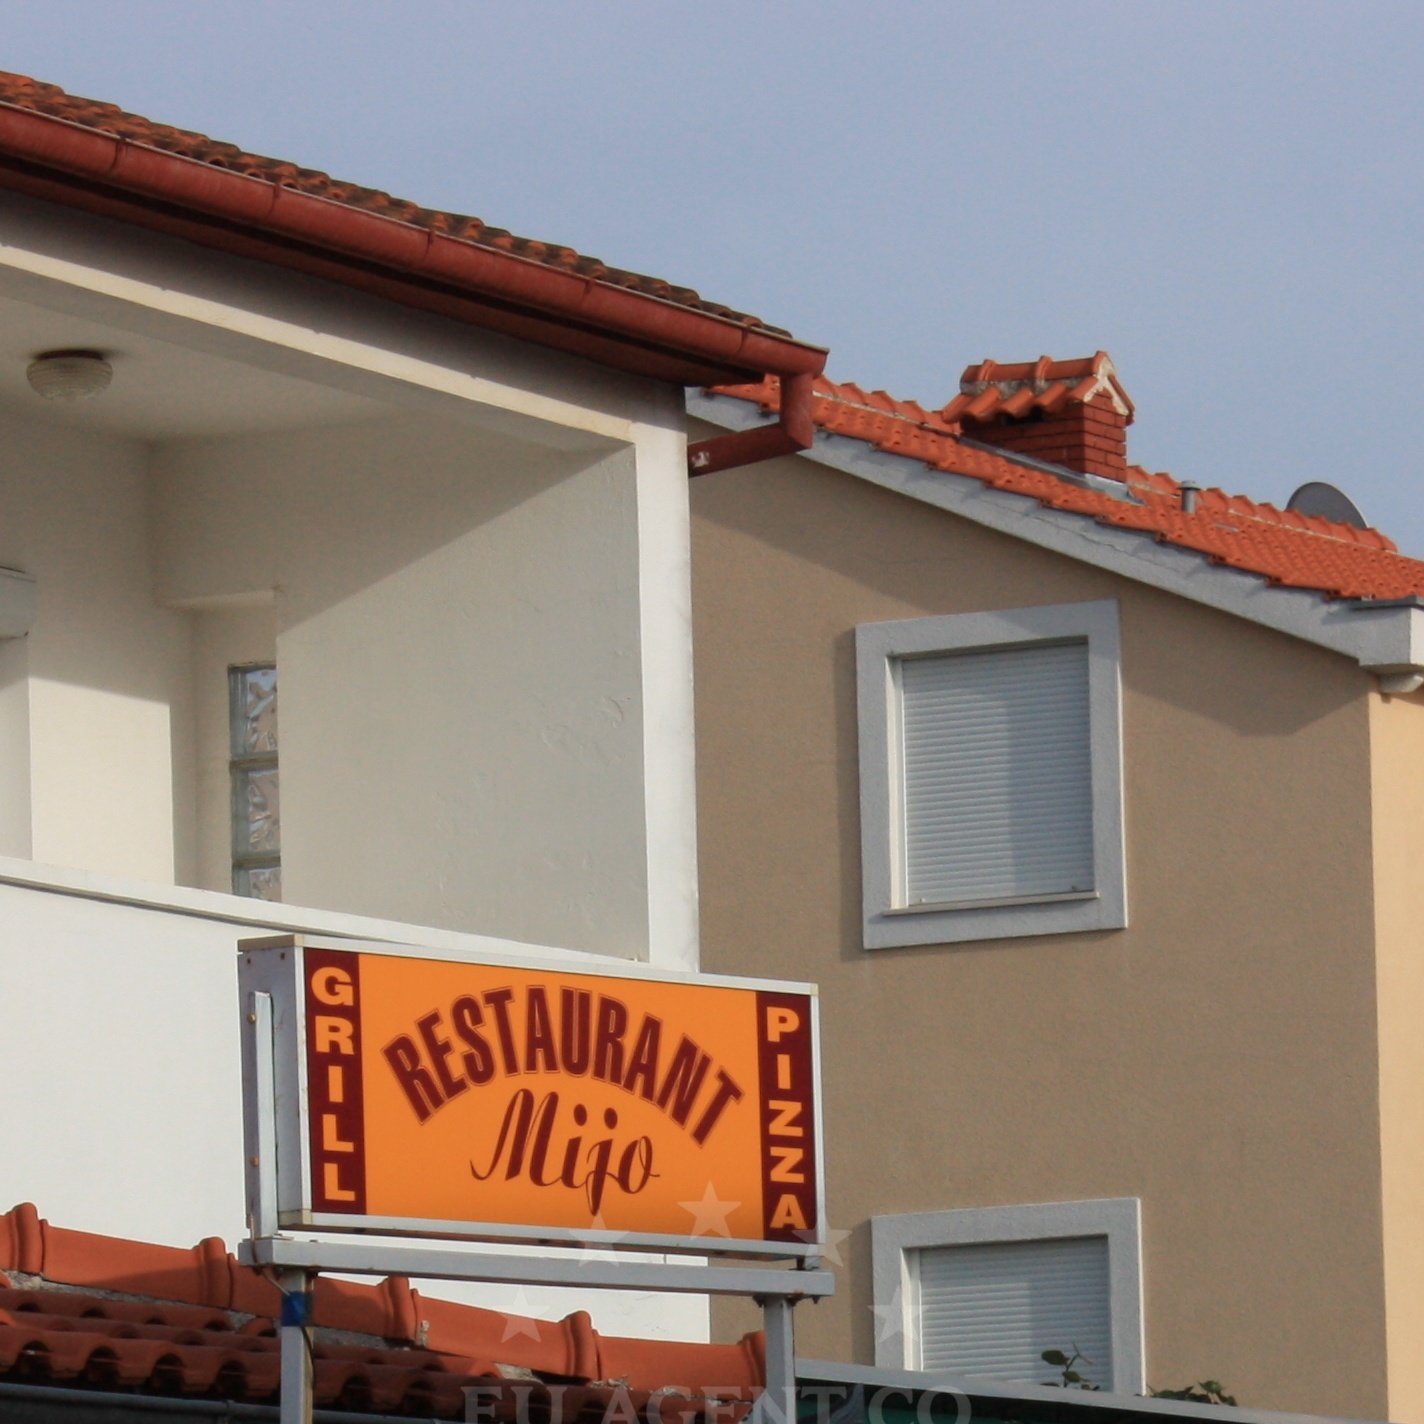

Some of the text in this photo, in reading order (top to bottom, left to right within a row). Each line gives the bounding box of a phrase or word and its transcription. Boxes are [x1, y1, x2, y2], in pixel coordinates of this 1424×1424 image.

[310, 967, 356, 1202] GRILL
[381, 985, 745, 1148] RESTAURANT
[470, 1088, 660, 1216] Mijo
[767, 1007, 807, 1229] PIZZA
